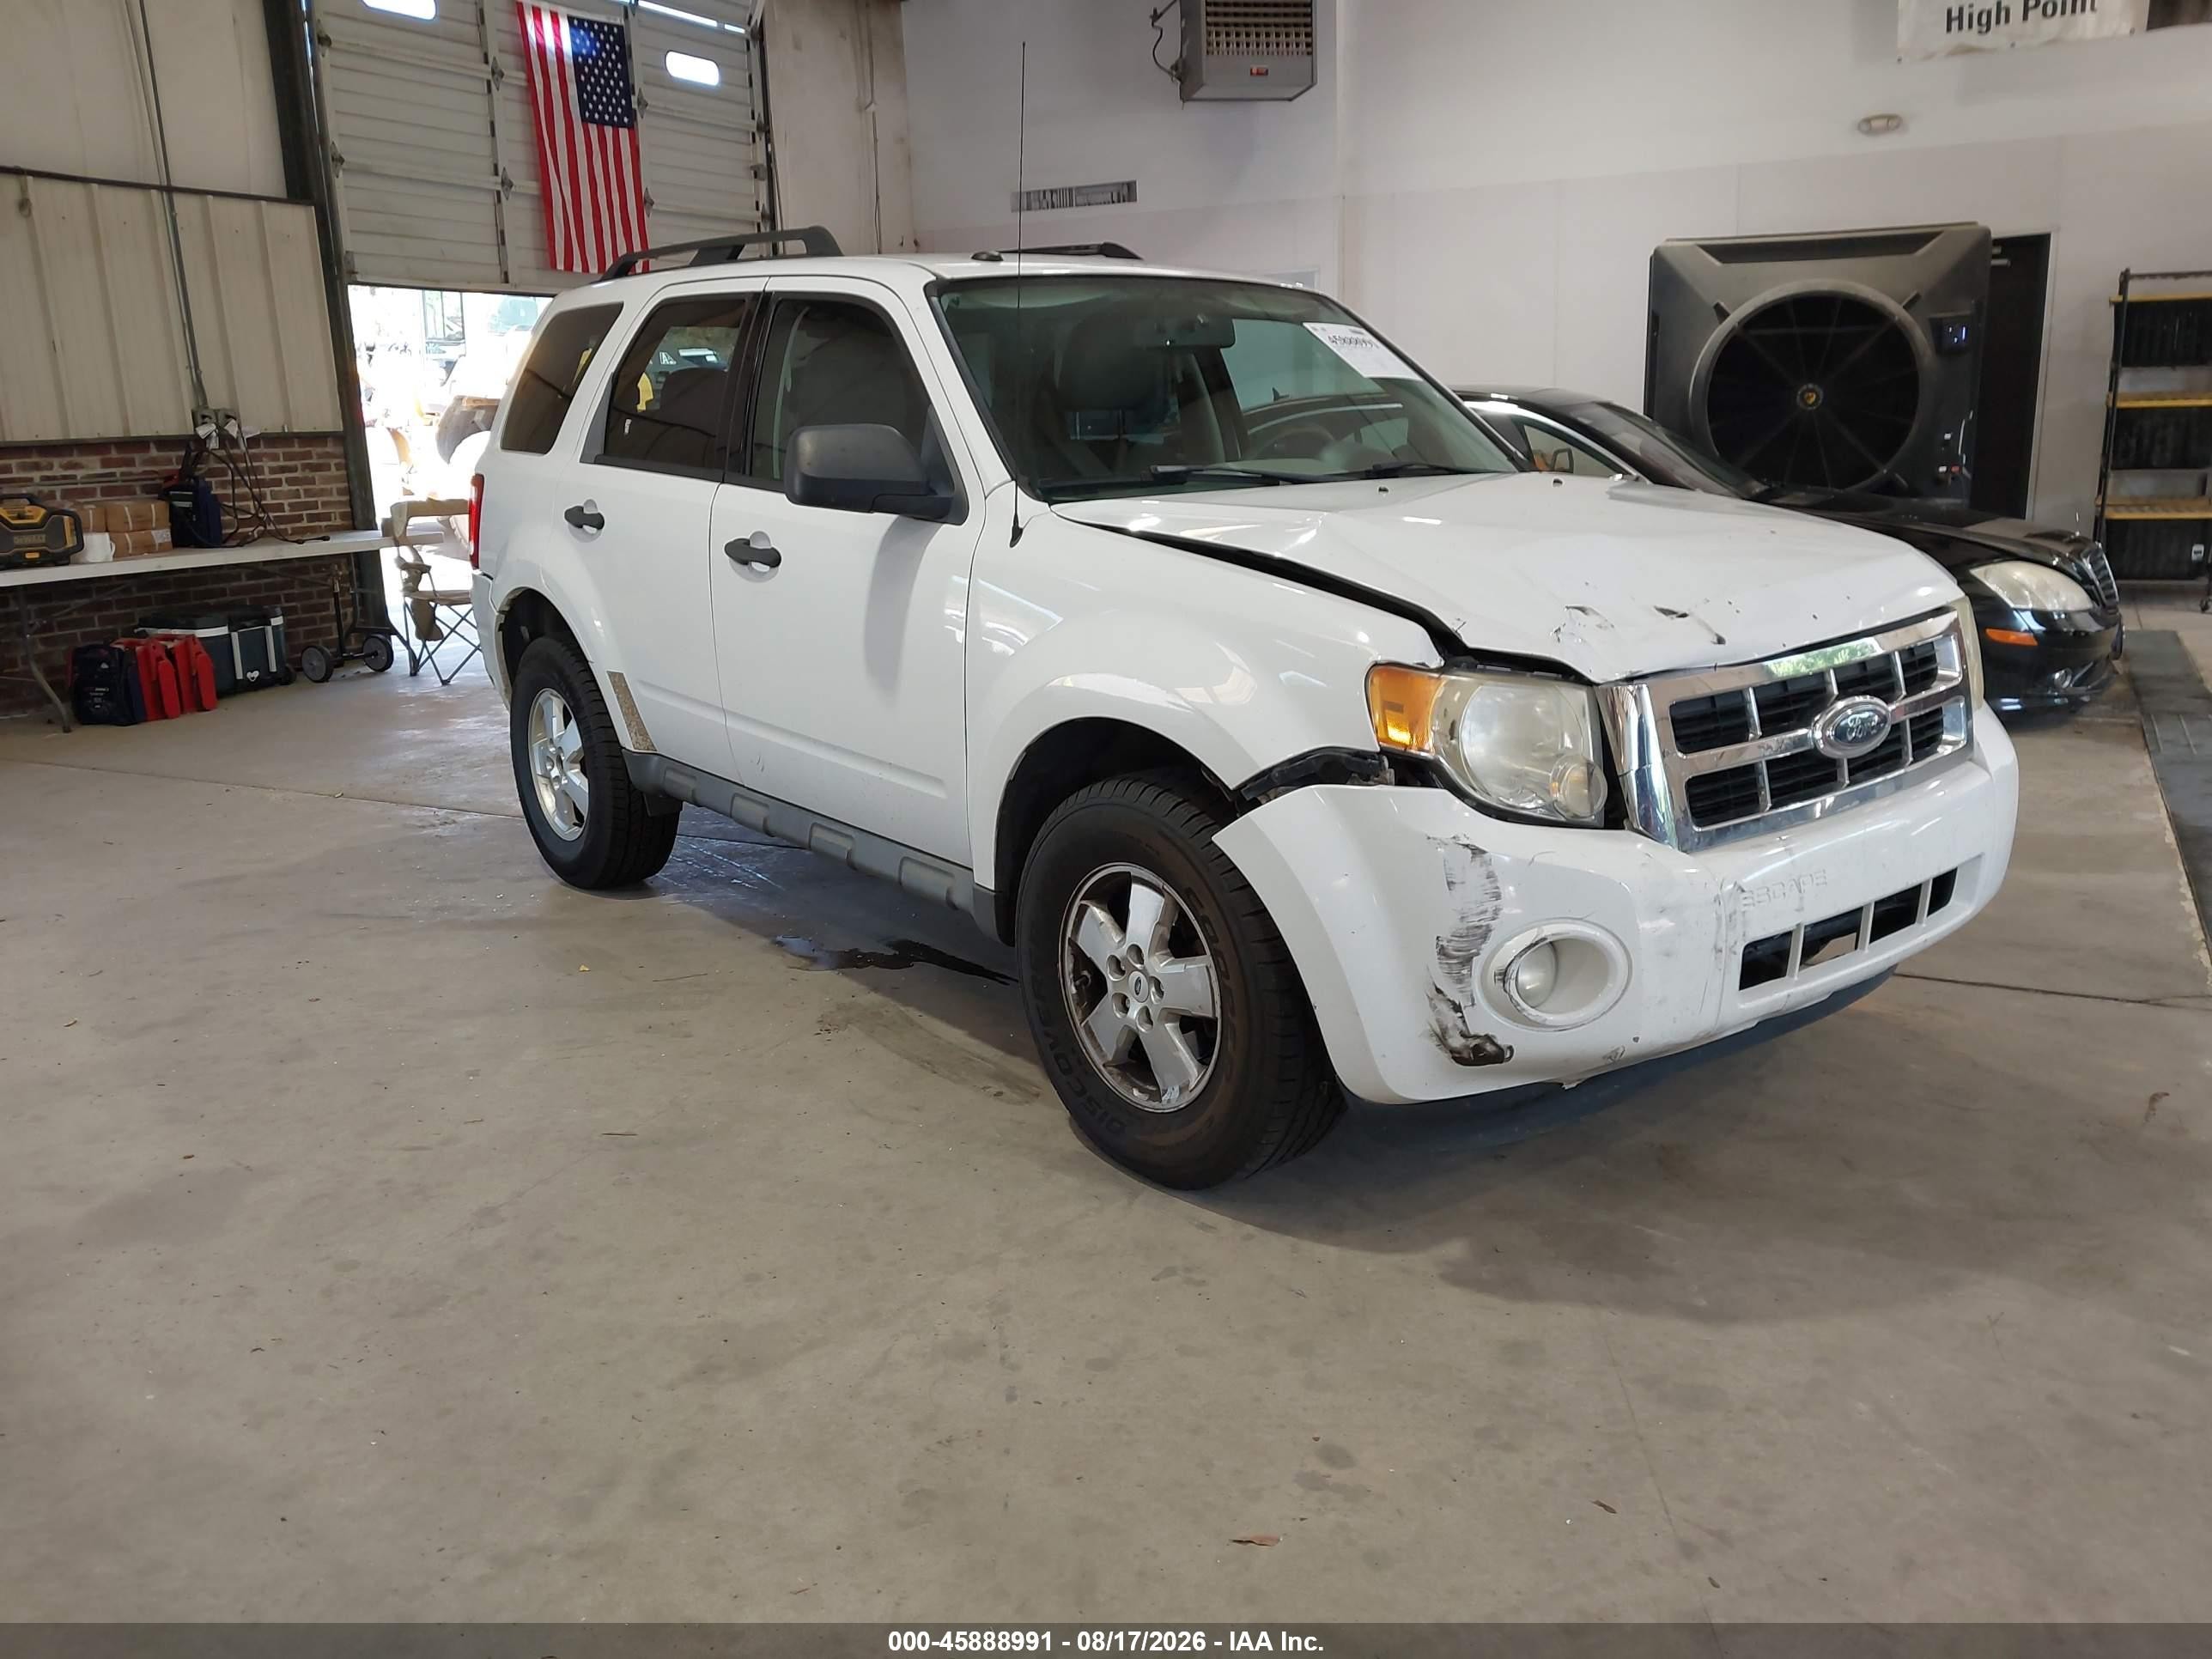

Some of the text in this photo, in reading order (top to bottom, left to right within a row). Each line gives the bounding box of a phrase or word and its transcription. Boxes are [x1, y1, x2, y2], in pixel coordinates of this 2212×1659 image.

[1946, 0, 2097, 35] High Point
[1843, 706, 1879, 741] Ford
[1741, 869, 1827, 908] ESCAPE
